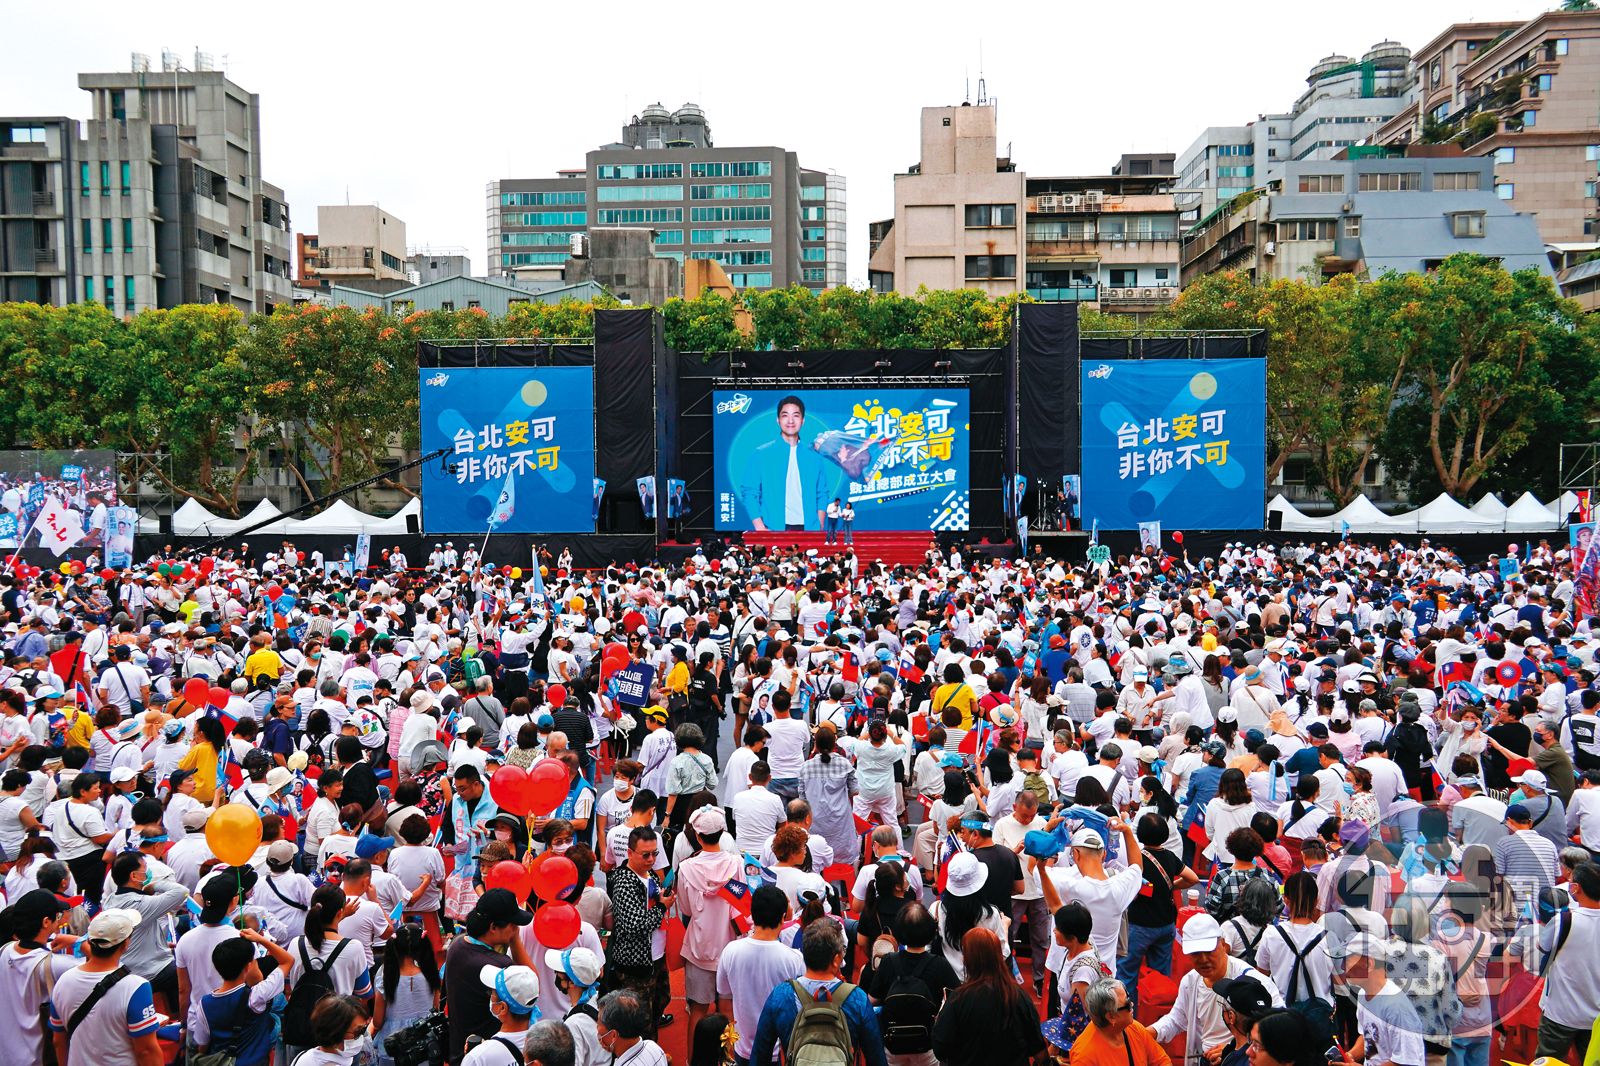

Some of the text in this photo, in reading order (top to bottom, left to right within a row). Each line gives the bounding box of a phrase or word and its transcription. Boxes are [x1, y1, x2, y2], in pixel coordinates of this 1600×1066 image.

[453, 416, 557, 455] 台北安可
[844, 409, 951, 440] 台北安可
[1116, 409, 1226, 450] 台北安可
[456, 446, 561, 485] 非你不可
[1118, 440, 1230, 480] 非你不可
[849, 468, 957, 495] 競選總部成立大會
[142, 1004, 156, 1018] 95
